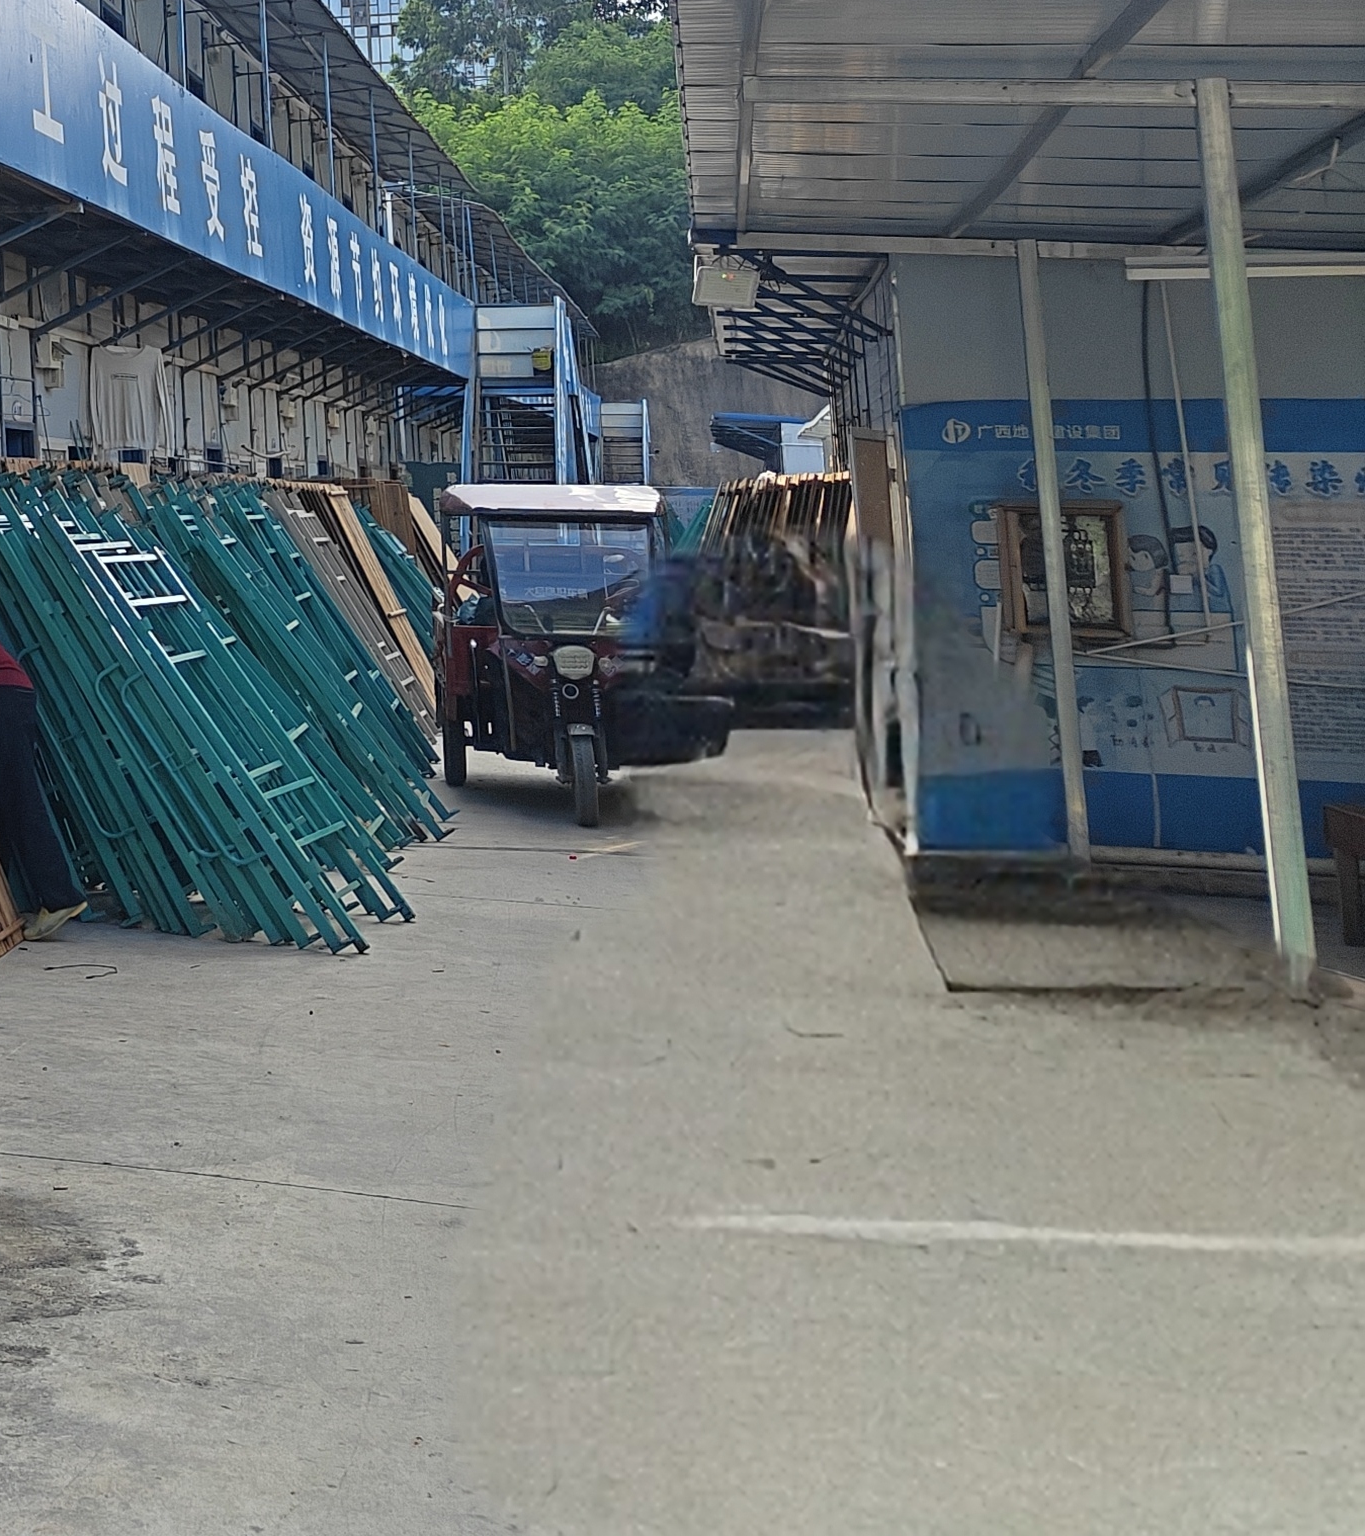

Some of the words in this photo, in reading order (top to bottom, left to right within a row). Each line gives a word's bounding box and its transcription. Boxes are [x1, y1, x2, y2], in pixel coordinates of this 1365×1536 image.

[977, 423, 1121, 441] 广西地建设集团
